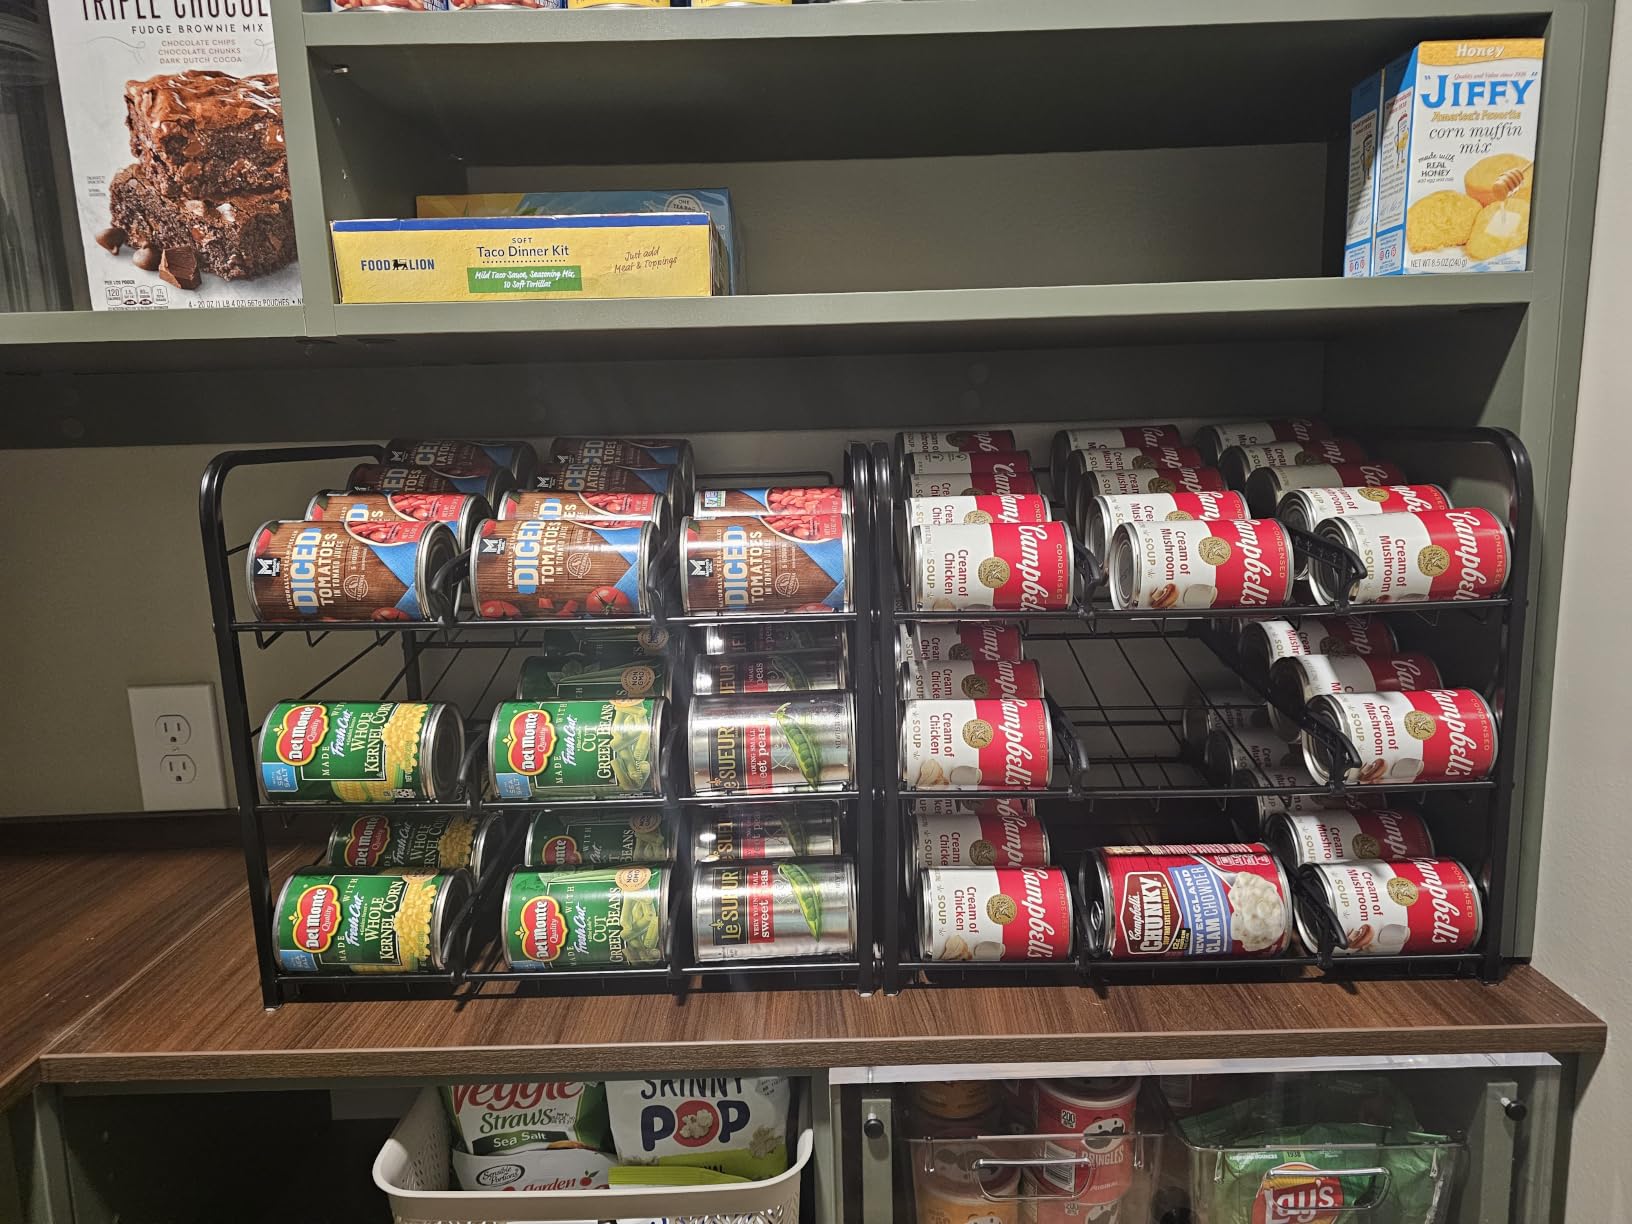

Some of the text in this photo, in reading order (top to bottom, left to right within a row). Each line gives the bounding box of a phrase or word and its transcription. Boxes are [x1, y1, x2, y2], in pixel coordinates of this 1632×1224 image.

[131, 23, 265, 35] FUDGE BROWNIE MIX
[208, 47, 241, 55] CHUNKS
[1456, 43, 1505, 57] Honey
[1429, 122, 1523, 140] corn muffin
[1460, 139, 1492, 154] mix
[1418, 152, 1456, 163] made with
[1420, 169, 1451, 177] HONEY
[1426, 161, 1447, 169] REAL
[361, 258, 436, 272] FOOD LION
[476, 244, 570, 257] Taco Dinner Kit
[614, 263, 634, 274] Meat
[644, 256, 678, 269] Toppings
[624, 245, 660, 262] Just add
[1410, 258, 1449, 268] NET WT 8.5 OZ
[474, 270, 490, 280] Mild
[491, 270, 506, 279] Taco
[530, 269, 561, 280] Seasoning
[503, 279, 552, 289] 10 Soft Tortillas
[1347, 497, 1358, 510] of
[513, 521, 546, 587] DICED
[540, 521, 561, 585] TOMATOES
[722, 529, 749, 605] DICED
[749, 531, 765, 604] TOMATOES
[1144, 537, 1156, 566] SOUP
[1160, 528, 1175, 581] Mushroom
[1175, 530, 1191, 576] Cream of
[1272, 526, 1285, 578] CONDENSED
[1365, 548, 1375, 581] SOUP
[1379, 535, 1394, 593] Mushroom
[1394, 538, 1408, 587] Cream of
[290, 530, 322, 608] DICED
[318, 533, 338, 606] TOMATOES
[331, 560, 343, 588] TOMATO
[926, 558, 936, 589] SOUP
[944, 552, 955, 595] Chicken
[957, 549, 969, 597] Cream of
[1056, 543, 1064, 600] CONDENSED
[756, 662, 764, 685] peas
[289, 706, 316, 760] Del Monte
[307, 718, 322, 742] Quality
[351, 711, 374, 752] WHOLE
[364, 702, 394, 773] KERNEL CORN
[521, 712, 539, 770] Del Monte
[538, 726, 548, 753] Quality
[582, 725, 597, 752] CUT
[912, 719, 921, 749] SOUP
[929, 715, 940, 755] Chicken
[942, 713, 955, 758] Cream of
[1350, 713, 1365, 742] SOUP
[1363, 702, 1383, 755] Mushroom
[1379, 705, 1398, 750] Cream of
[1470, 698, 1489, 751] CONDENSED
[331, 728, 346, 758] Fresh
[561, 739, 577, 766] Fresh
[596, 704, 614, 779] GREEN BEANS
[718, 726, 736, 779] SUEUR
[322, 746, 330, 776] MADE
[553, 755, 564, 784] MADE
[410, 823, 430, 860] WHOLE
[619, 829, 634, 862] BEANS
[951, 832, 961, 863] Cream
[1329, 826, 1345, 858] Cream
[632, 869, 640, 883] GMO
[1450, 865, 1474, 918] CONDENSED
[565, 886, 575, 914] WITH
[937, 894, 947, 925] SOUP
[954, 889, 964, 931] Chicken
[1195, 866, 1221, 954] CLAM CHOWDER
[1335, 879, 1350, 908] SOUP
[1346, 868, 1369, 922] Mushroom
[1361, 871, 1384, 917] Cream of
[306, 888, 327, 948] Del Monte
[322, 905, 333, 932] Quality
[337, 878, 358, 962] MADE WITH
[346, 892, 364, 947] Fresh Cut
[365, 897, 384, 942] WHOLE
[380, 880, 403, 960] KERNEL CORN
[607, 887, 623, 963] GREEN BEANS
[760, 900, 770, 938] sweet
[966, 886, 980, 935] Cream of
[1128, 892, 1140, 941] Campbell's
[1140, 876, 1158, 952] CHUNKY
[1181, 870, 1205, 954] NEW ENGLAND
[533, 900, 549, 958] Del Monte
[549, 918, 559, 944] Quality
[573, 927, 590, 954] Fresh
[593, 915, 607, 943] CUT
[480, 1107, 554, 1134] Straws
[641, 1100, 751, 1151] POP
[493, 1130, 547, 1148] Sea Salt
[481, 1165, 513, 1180] Sensible
[1080, 1146, 1125, 1169] PRINGLES
[490, 1172, 520, 1187] Portions
[1264, 1178, 1336, 1224] Lay's
